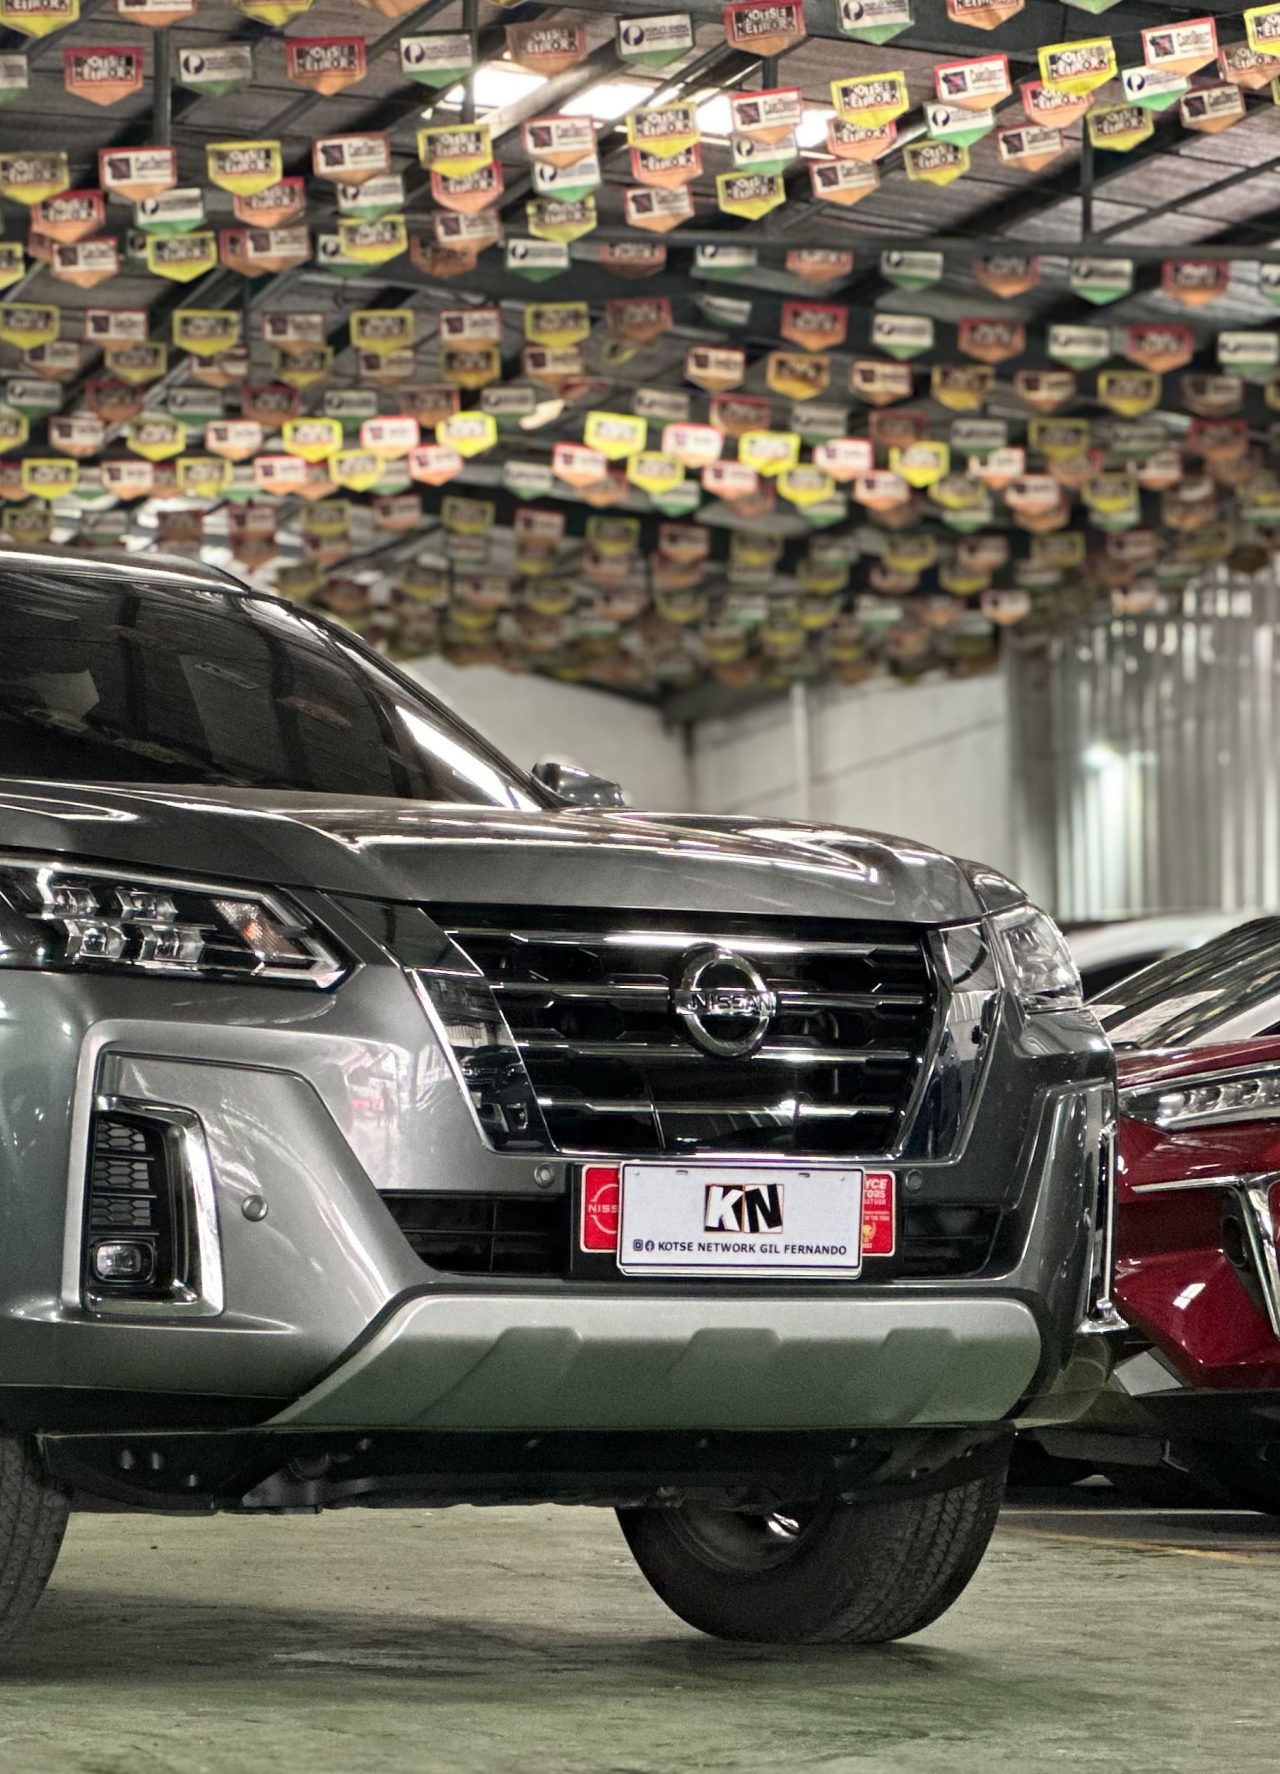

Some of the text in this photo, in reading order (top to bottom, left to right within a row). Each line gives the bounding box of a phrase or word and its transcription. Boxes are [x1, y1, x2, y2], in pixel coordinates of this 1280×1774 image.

[865, 1178, 888, 1189] YCE
[864, 1190, 886, 1198] TORS
[588, 1204, 619, 1213] NISS
[705, 1183, 784, 1233] KN
[658, 1241, 847, 1256] KOTSE NETWORK GIL FERNANDO
